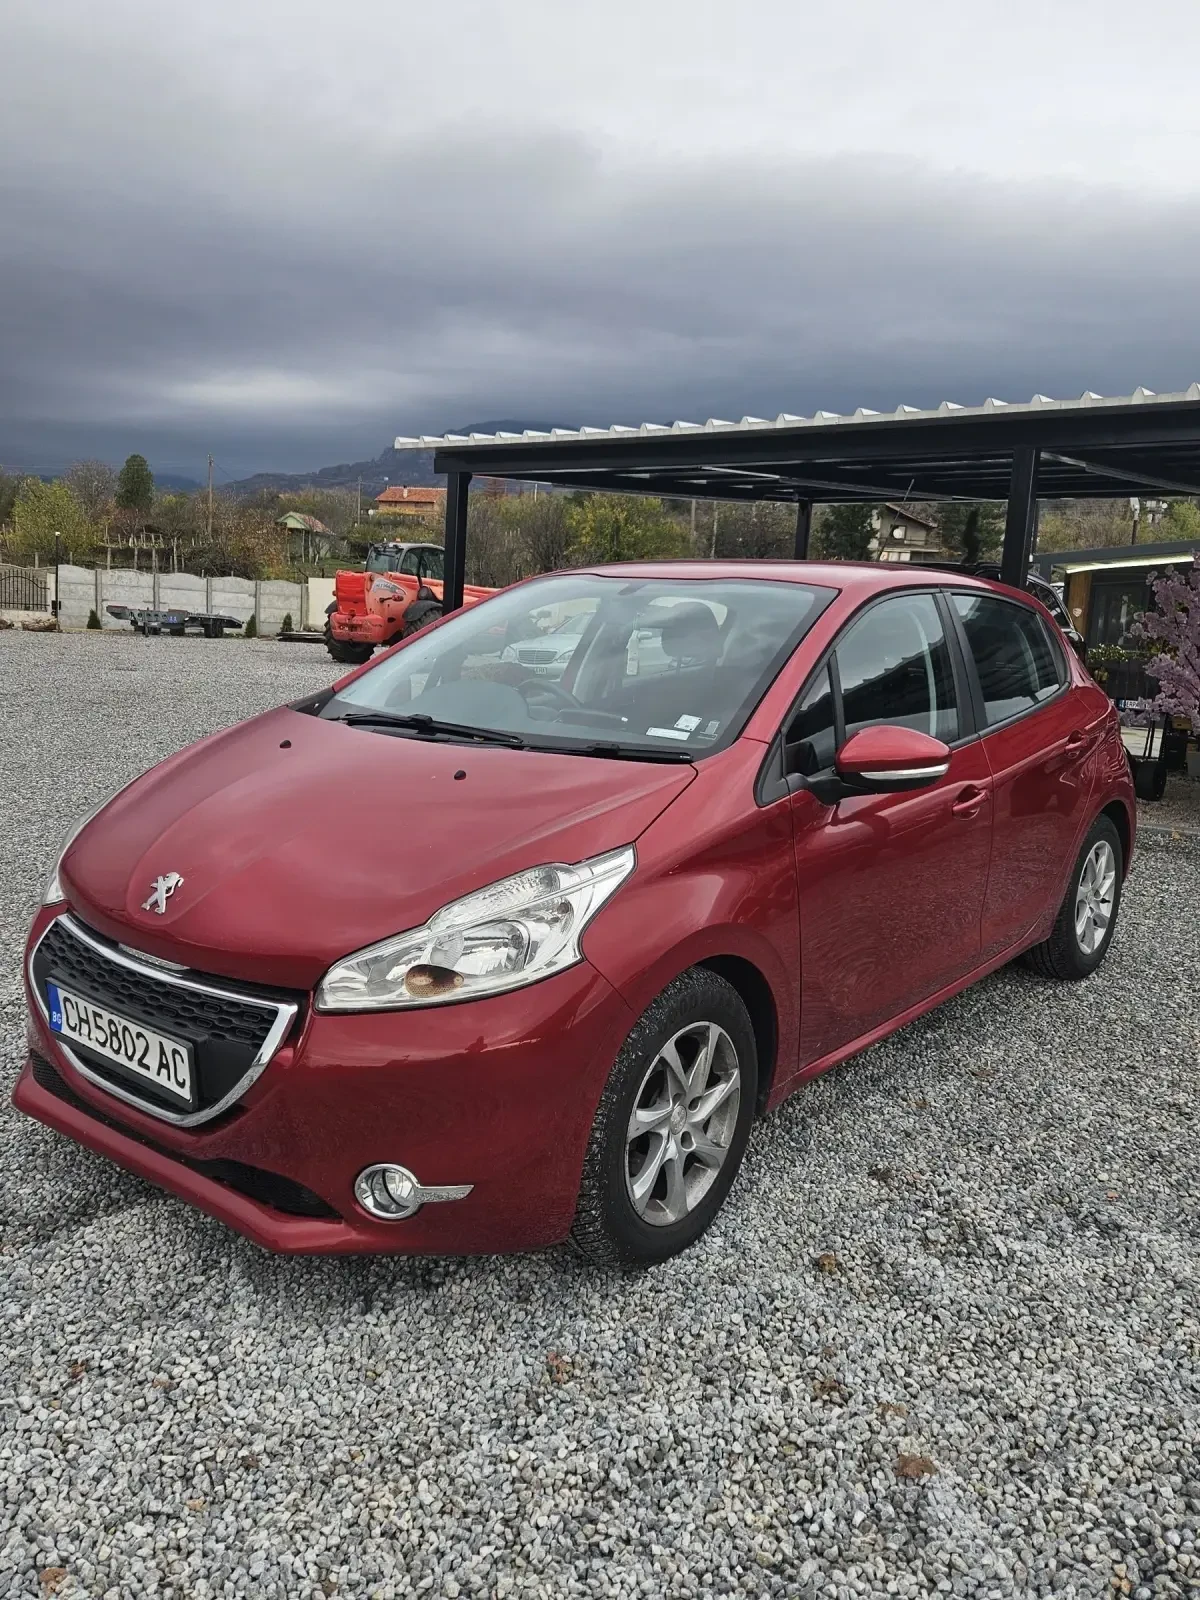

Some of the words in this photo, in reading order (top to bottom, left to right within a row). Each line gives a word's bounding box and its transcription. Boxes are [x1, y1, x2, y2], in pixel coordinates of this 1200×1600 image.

[52, 1011, 62, 1025] BG
[62, 996, 151, 1072] CH5802
[156, 1040, 186, 1089] AC
